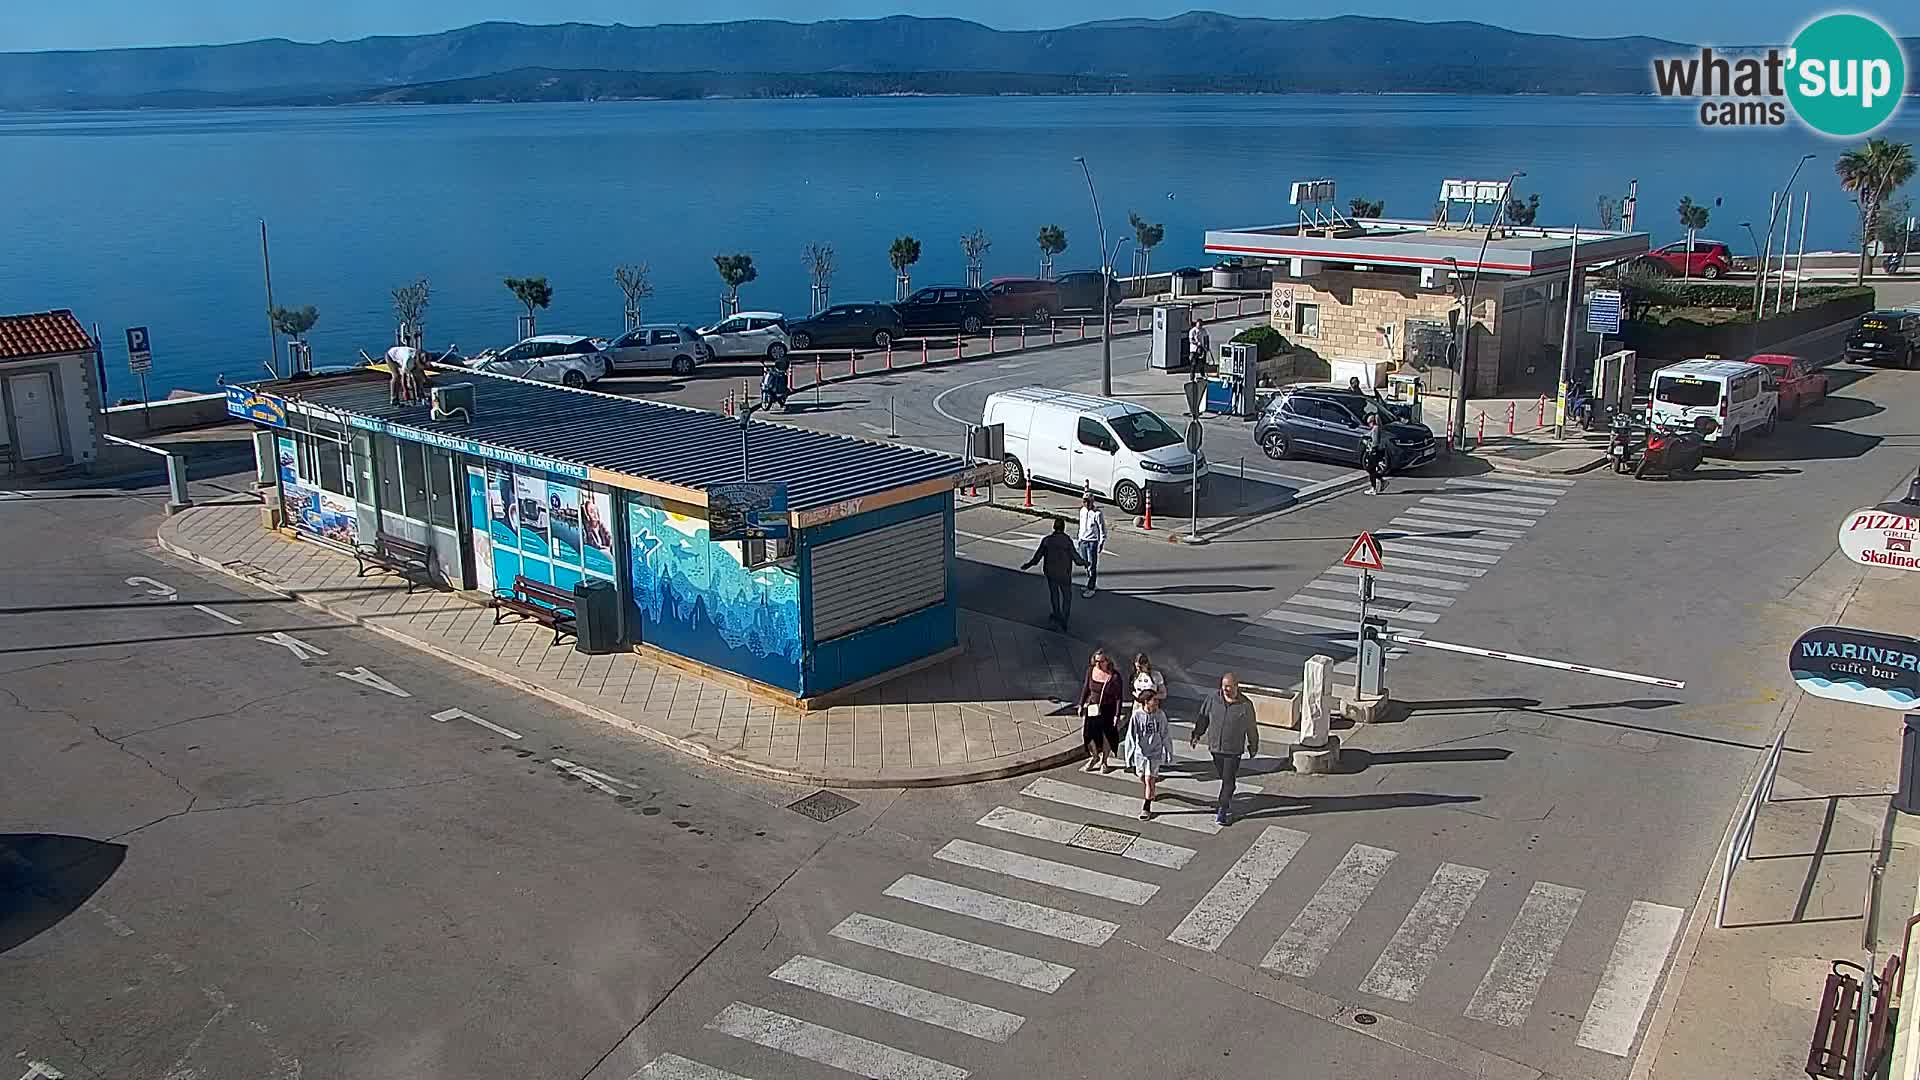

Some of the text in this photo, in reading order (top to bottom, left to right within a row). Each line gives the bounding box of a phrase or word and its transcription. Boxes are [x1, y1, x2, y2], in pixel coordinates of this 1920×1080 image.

[130, 330, 145, 349] P
[437, 436, 469, 451] POSTAJA
[479, 445, 494, 458] BUS
[494, 448, 527, 465] STATION
[529, 456, 556, 471] TICKET
[556, 463, 584, 477] OFFICE
[1849, 515, 1920, 533] PIZZE
[1883, 530, 1919, 540] GRILL
[1830, 662, 1900, 681] caffe bar
